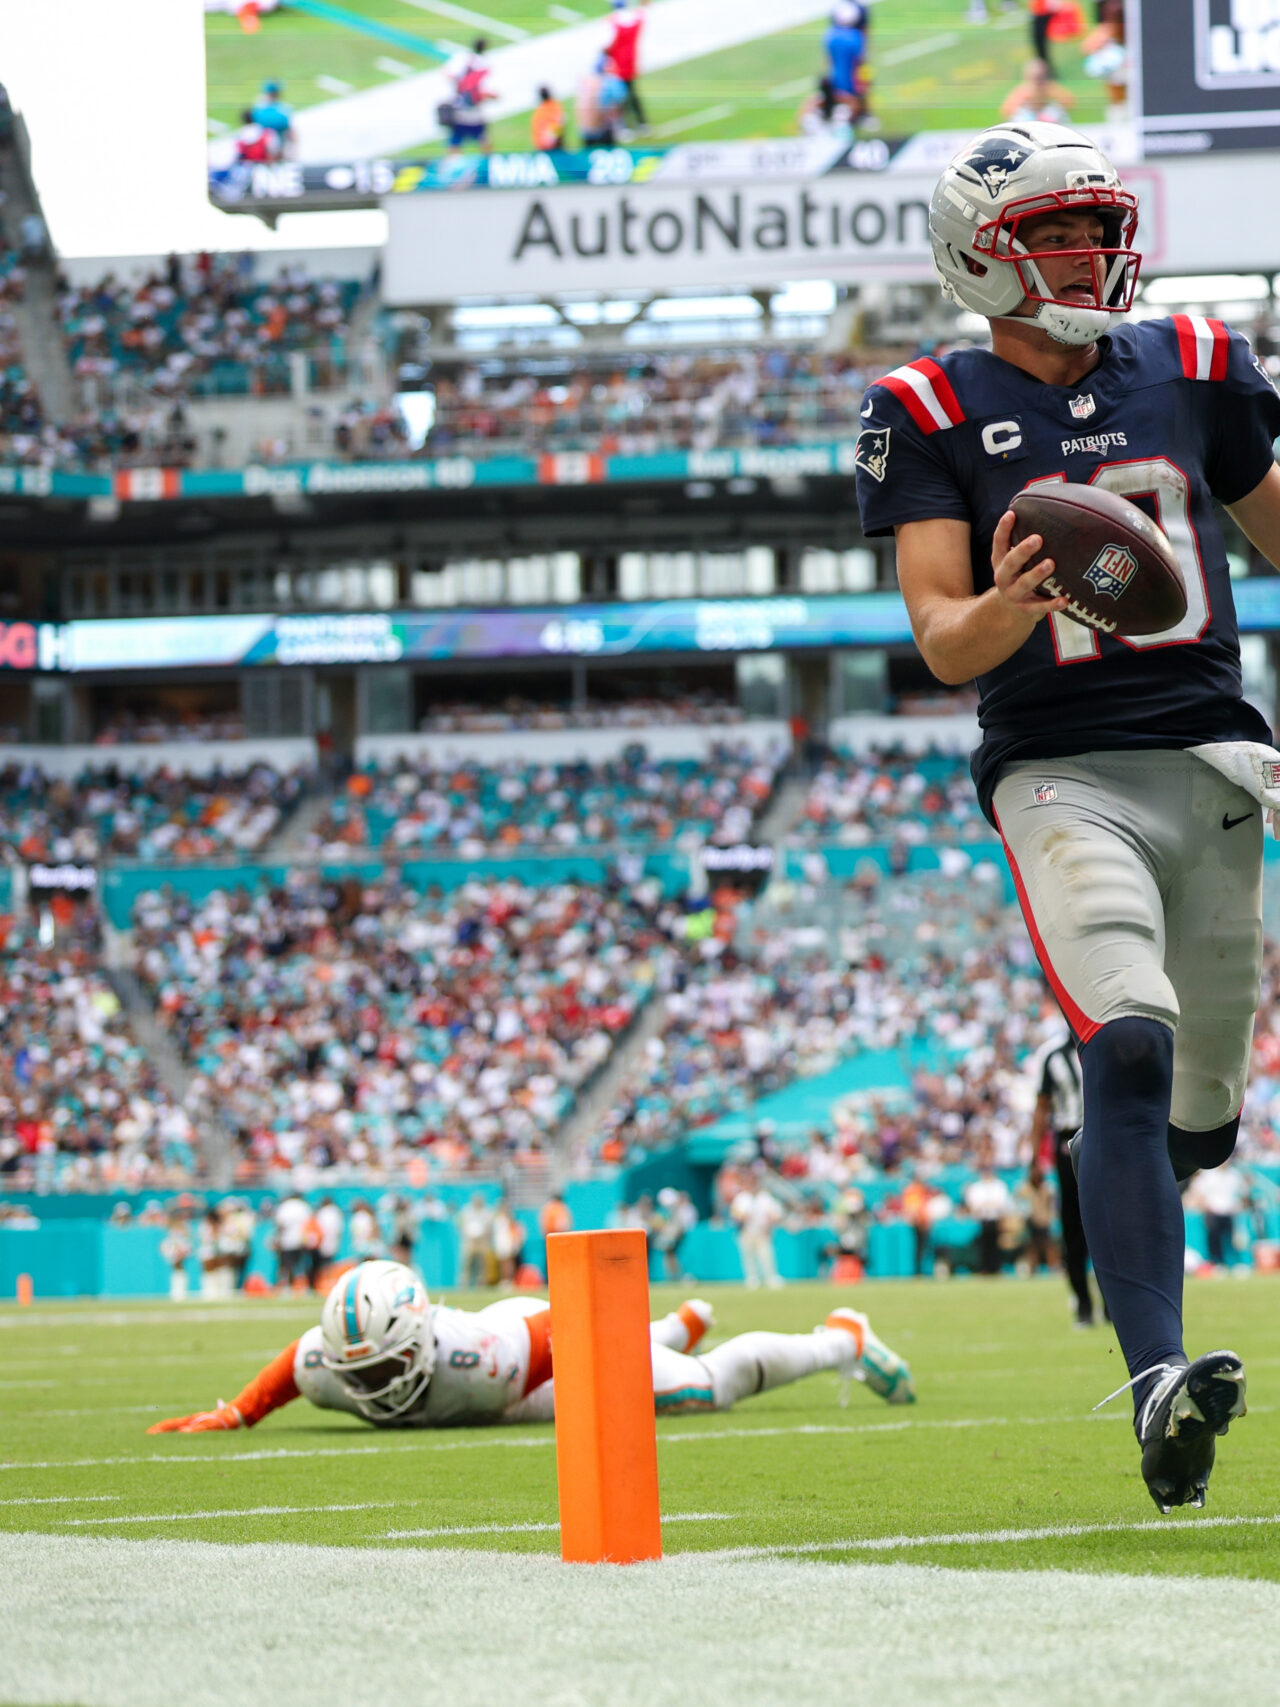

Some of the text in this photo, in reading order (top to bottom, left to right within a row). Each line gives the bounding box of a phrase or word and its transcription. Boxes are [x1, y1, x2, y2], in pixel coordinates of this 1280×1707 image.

[488, 153, 560, 188] MIA
[513, 192, 929, 260] AutoNation
[981, 420, 1022, 456] C
[1061, 431, 1128, 456] PATRIOTS
[1101, 549, 1135, 583] NFL
[450, 1350, 481, 1369] 8
